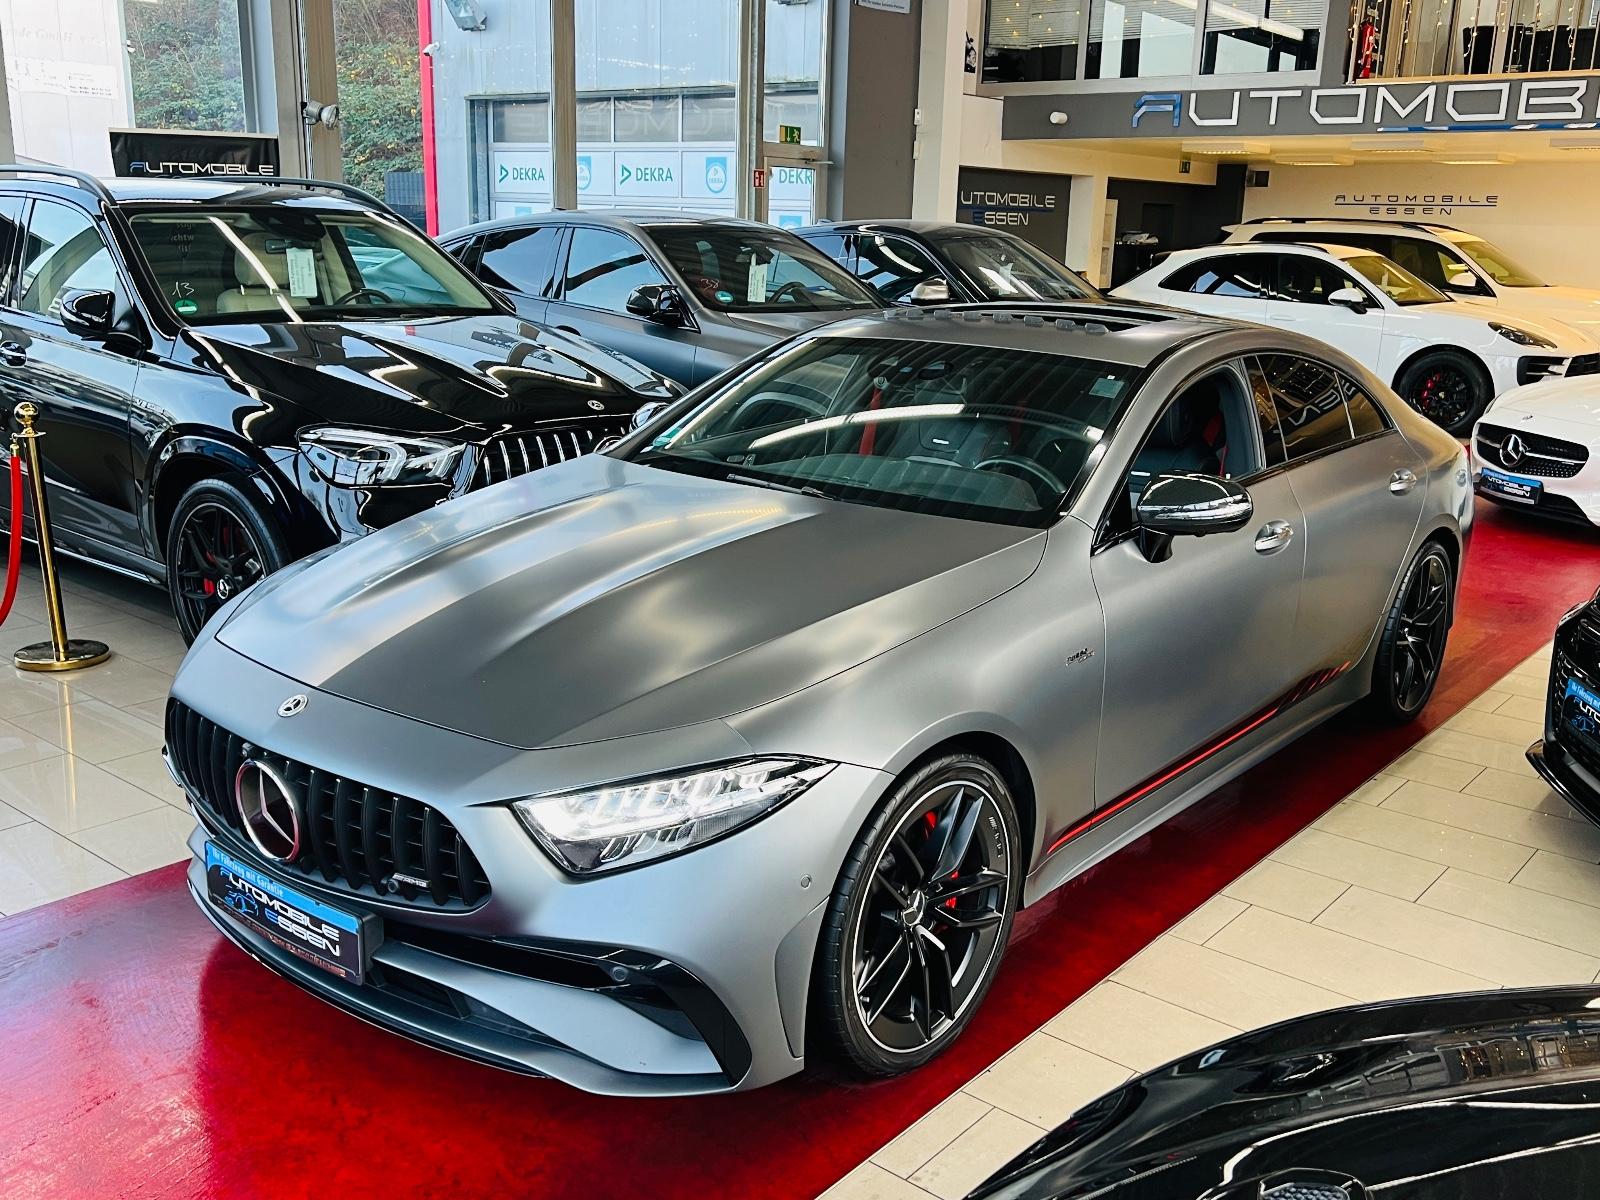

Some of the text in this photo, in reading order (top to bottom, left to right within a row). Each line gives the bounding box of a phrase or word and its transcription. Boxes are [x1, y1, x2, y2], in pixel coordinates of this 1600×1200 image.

[129, 161, 274, 176] AUTOMOBILE
[512, 167, 545, 181] DEKRA
[635, 167, 674, 182] DEKRA
[1334, 194, 1498, 204] AUTOMOBILE
[972, 210, 1029, 226] ESSEN
[1369, 206, 1452, 216] ESSEN
[172, 281, 196, 298] 13
[220, 852, 245, 879] Fahrzeug
[246, 869, 256, 882] mit
[256, 874, 284, 898] Garantie
[220, 866, 340, 942] AUTOMOBILE
[265, 908, 341, 957] ESSEN
